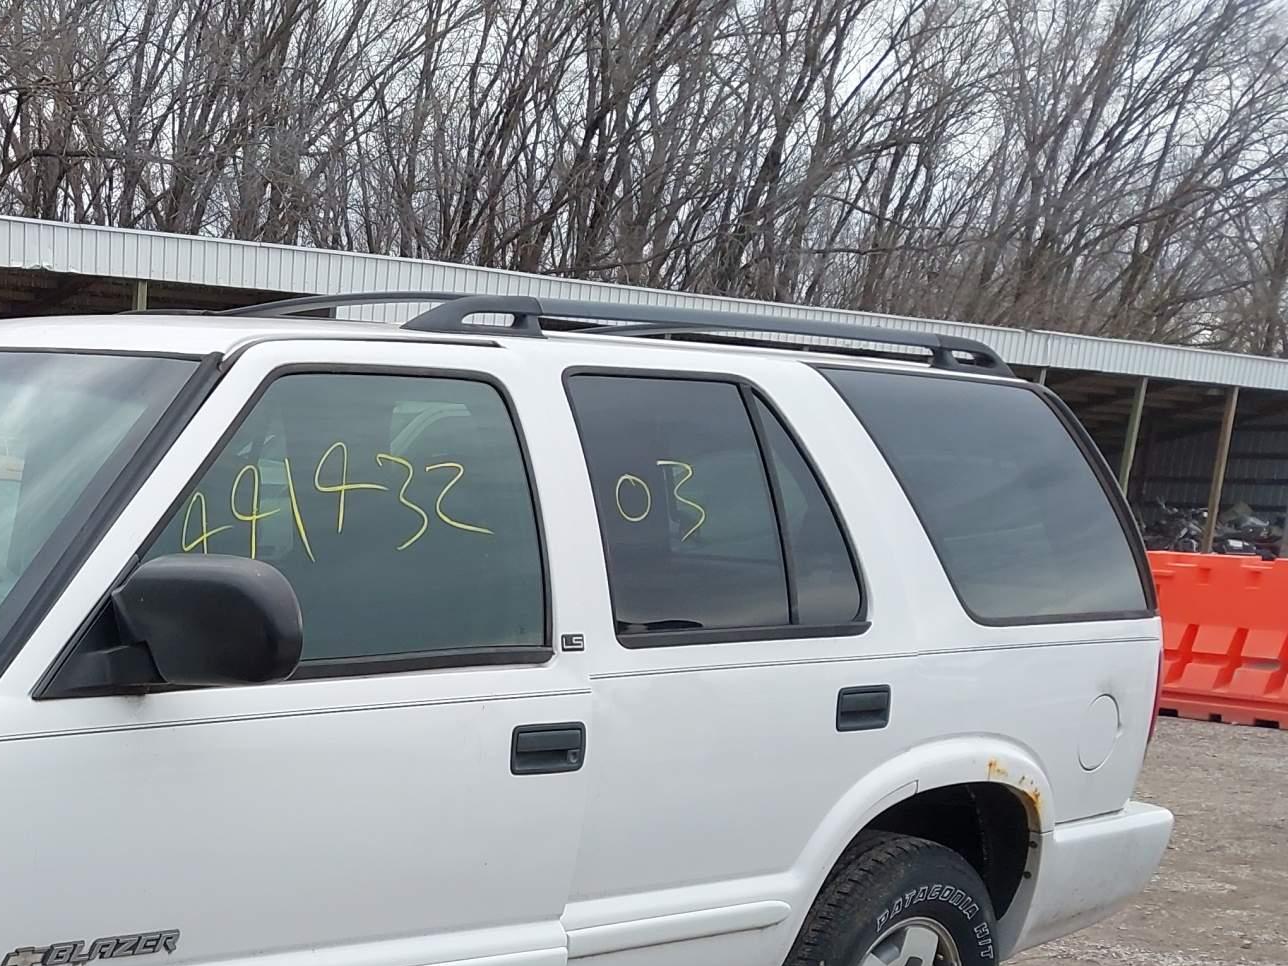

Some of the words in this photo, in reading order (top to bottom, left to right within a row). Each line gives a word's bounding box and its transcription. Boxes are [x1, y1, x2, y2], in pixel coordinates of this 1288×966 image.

[616, 460, 706, 541] 03
[562, 635, 583, 650] LS
[876, 884, 979, 932] PATAGONIA
[41, 929, 180, 966] BLAZER
